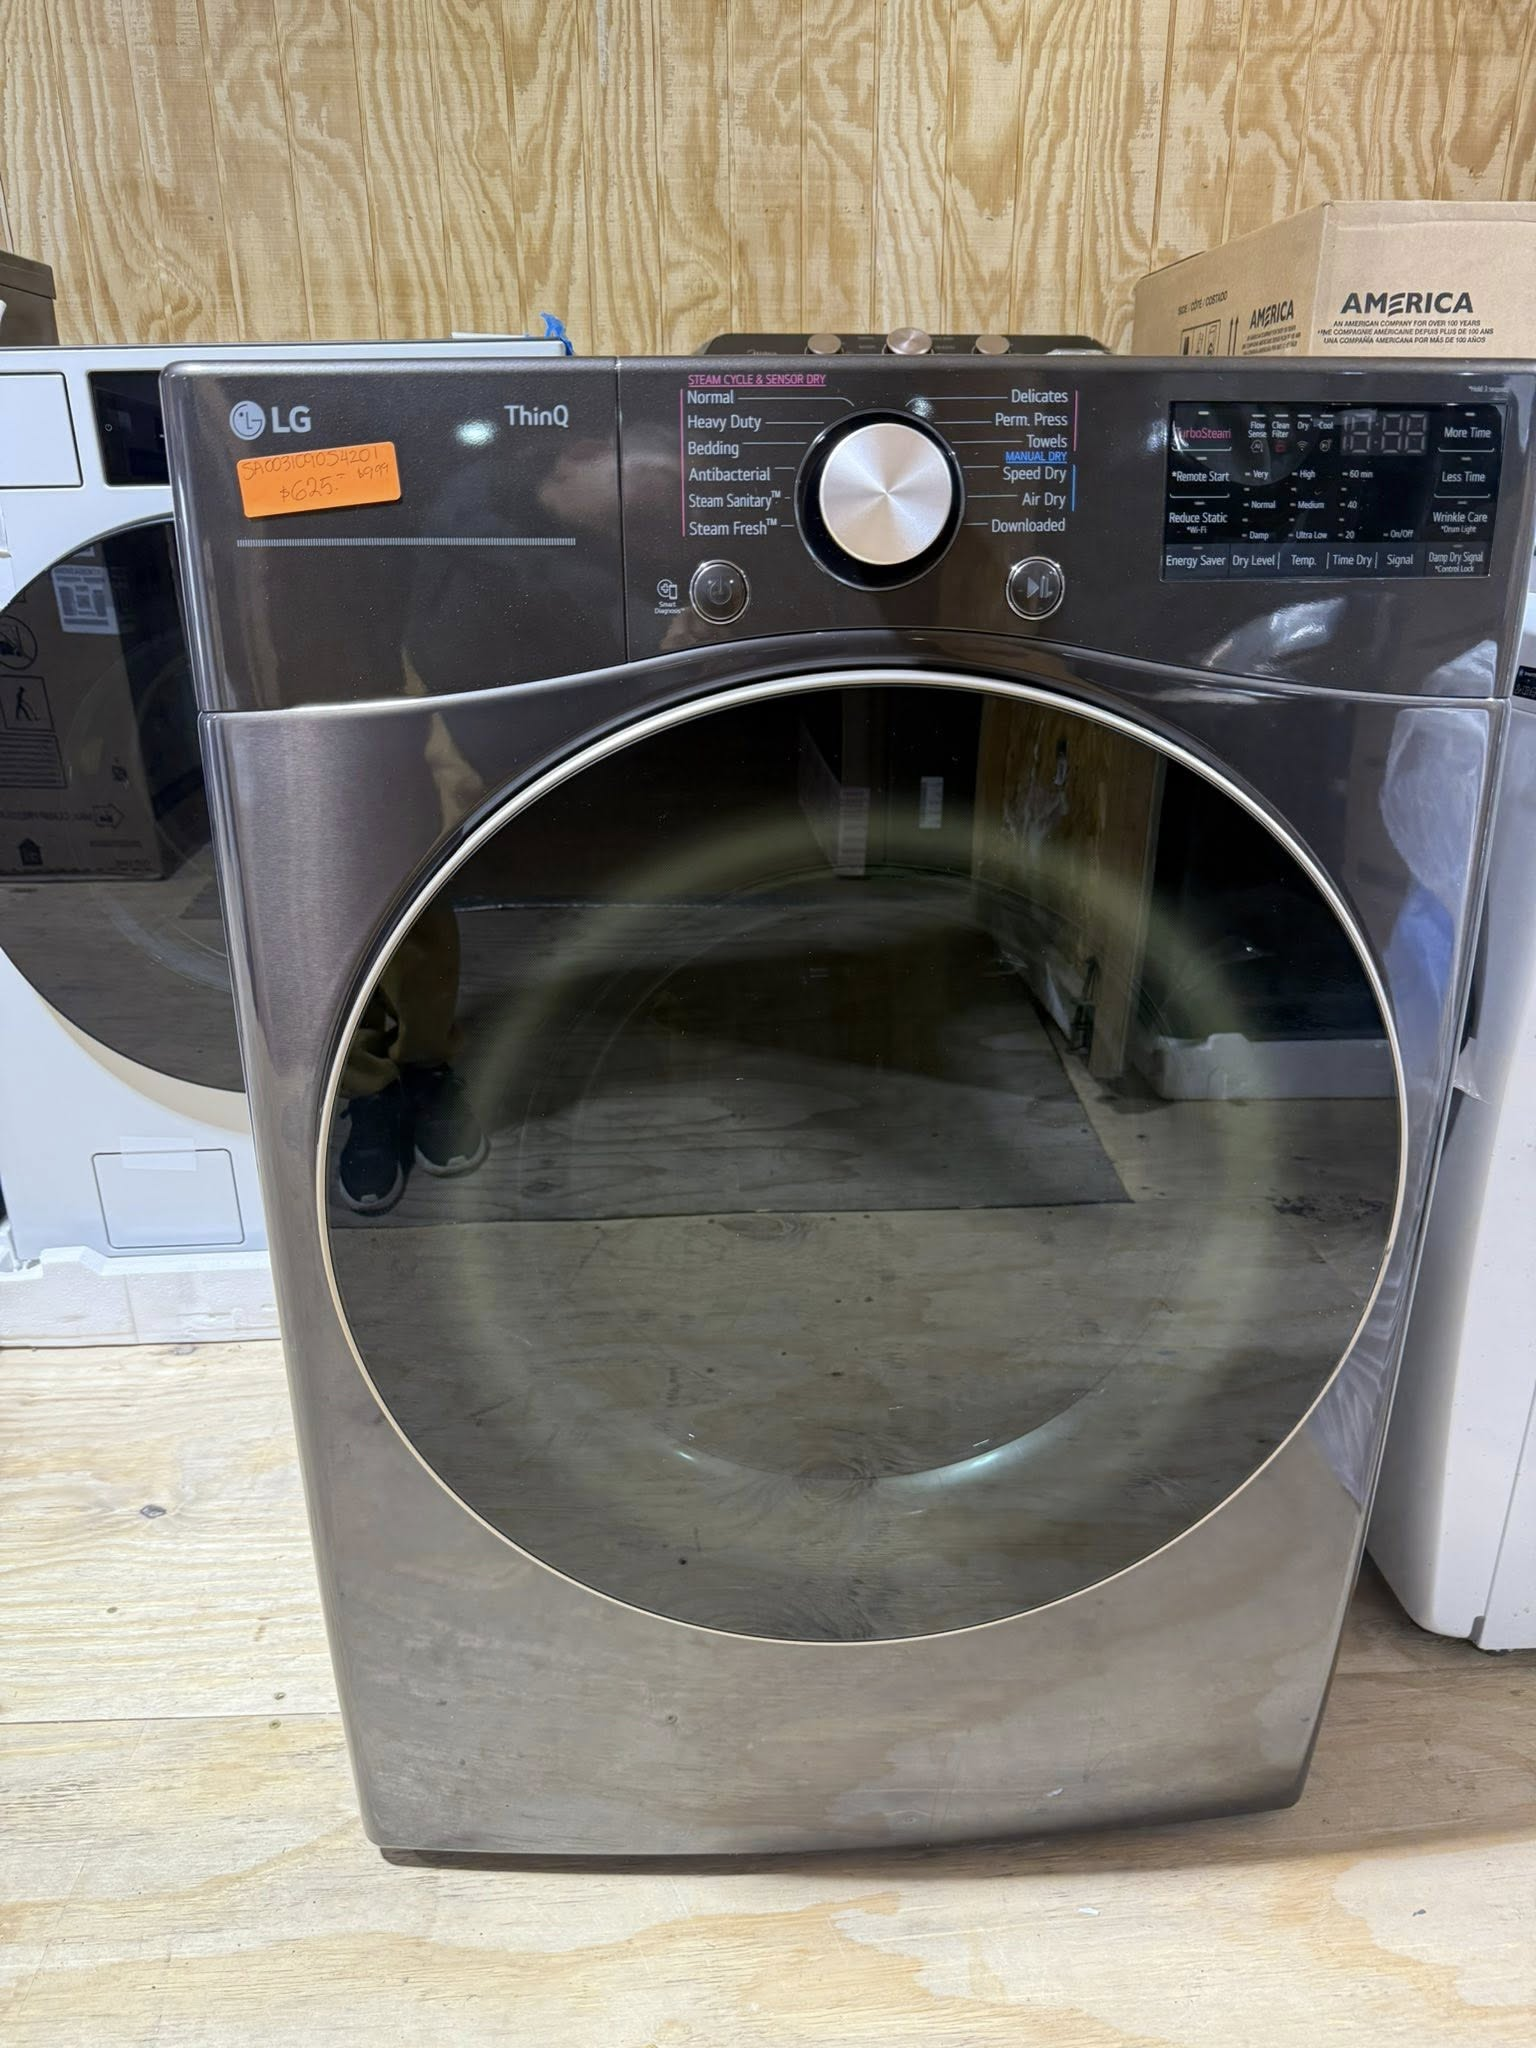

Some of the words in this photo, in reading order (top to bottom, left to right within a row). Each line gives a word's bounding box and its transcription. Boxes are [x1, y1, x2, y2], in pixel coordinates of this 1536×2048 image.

[1340, 292, 1474, 317] AMERICA
[1250, 299, 1294, 329] AMERICA
[688, 374, 721, 385] STEAM
[723, 374, 753, 385] CYCLE
[755, 374, 763, 385] &
[765, 374, 804, 385] SENSOR
[806, 374, 826, 385] DRY
[687, 389, 734, 404] Normal
[1011, 388, 1068, 403] Delicates
[271, 405, 312, 433] LG
[504, 404, 570, 428] ThinQ
[995, 412, 1031, 426] Perm.
[1034, 412, 1068, 426] Press
[687, 414, 727, 432] Heavy
[730, 414, 762, 432] Duty
[1250, 421, 1266, 429] Flow
[1272, 421, 1290, 429] Clean
[1297, 421, 1309, 431] Dry
[1318, 421, 1334, 430] Cool
[1248, 430, 1267, 438] Sense
[1272, 430, 1289, 438] Filter
[1444, 426, 1468, 438] More
[1470, 426, 1492, 438] Time
[1026, 433, 1068, 448] Towels
[688, 441, 739, 458] Bedding
[1005, 451, 1046, 461] MANUAL
[1048, 451, 1067, 461] DRY
[688, 466, 771, 481] Antibacterial
[1003, 466, 1041, 484] Speed
[1044, 466, 1067, 484] Dry
[1208, 470, 1230, 482] Start
[1253, 470, 1269, 480] Very
[1300, 470, 1316, 481] High
[1350, 470, 1360, 478] 60
[1360, 470, 1374, 478] min
[1441, 471, 1462, 483] Less
[1464, 471, 1486, 483] Time
[688, 493, 724, 508] Steam
[1022, 492, 1041, 506] Air
[1044, 492, 1066, 510] Dry
[1251, 500, 1276, 509] Normal
[1298, 501, 1325, 509] Medium
[1347, 501, 1358, 509] 40
[1169, 512, 1200, 524] Reduce
[1202, 512, 1228, 524] Static
[1433, 511, 1466, 523] Wrinkle
[1467, 512, 1488, 522] Care
[689, 521, 729, 536] Steam
[991, 518, 1066, 533] Downloaded
[1461, 525, 1477, 534] Light
[1249, 531, 1269, 541] Damp
[1296, 531, 1312, 539] Ultra
[1313, 531, 1328, 539] Low
[1345, 530, 1355, 539] 20
[1390, 529, 1414, 539] On/Off
[1166, 554, 1198, 568] Energy
[1200, 554, 1226, 566] Saver
[1232, 555, 1249, 569] Dry
[1251, 554, 1275, 566] Level
[1291, 554, 1317, 568] Temp.
[1333, 554, 1354, 566] Time
[1356, 554, 1373, 568] Dry
[1386, 553, 1414, 567] Signal
[1428, 551, 1449, 564] Damp
[1450, 551, 1462, 564] Dry
[1463, 551, 1484, 564] Signal
[1460, 564, 1475, 572] Lock
